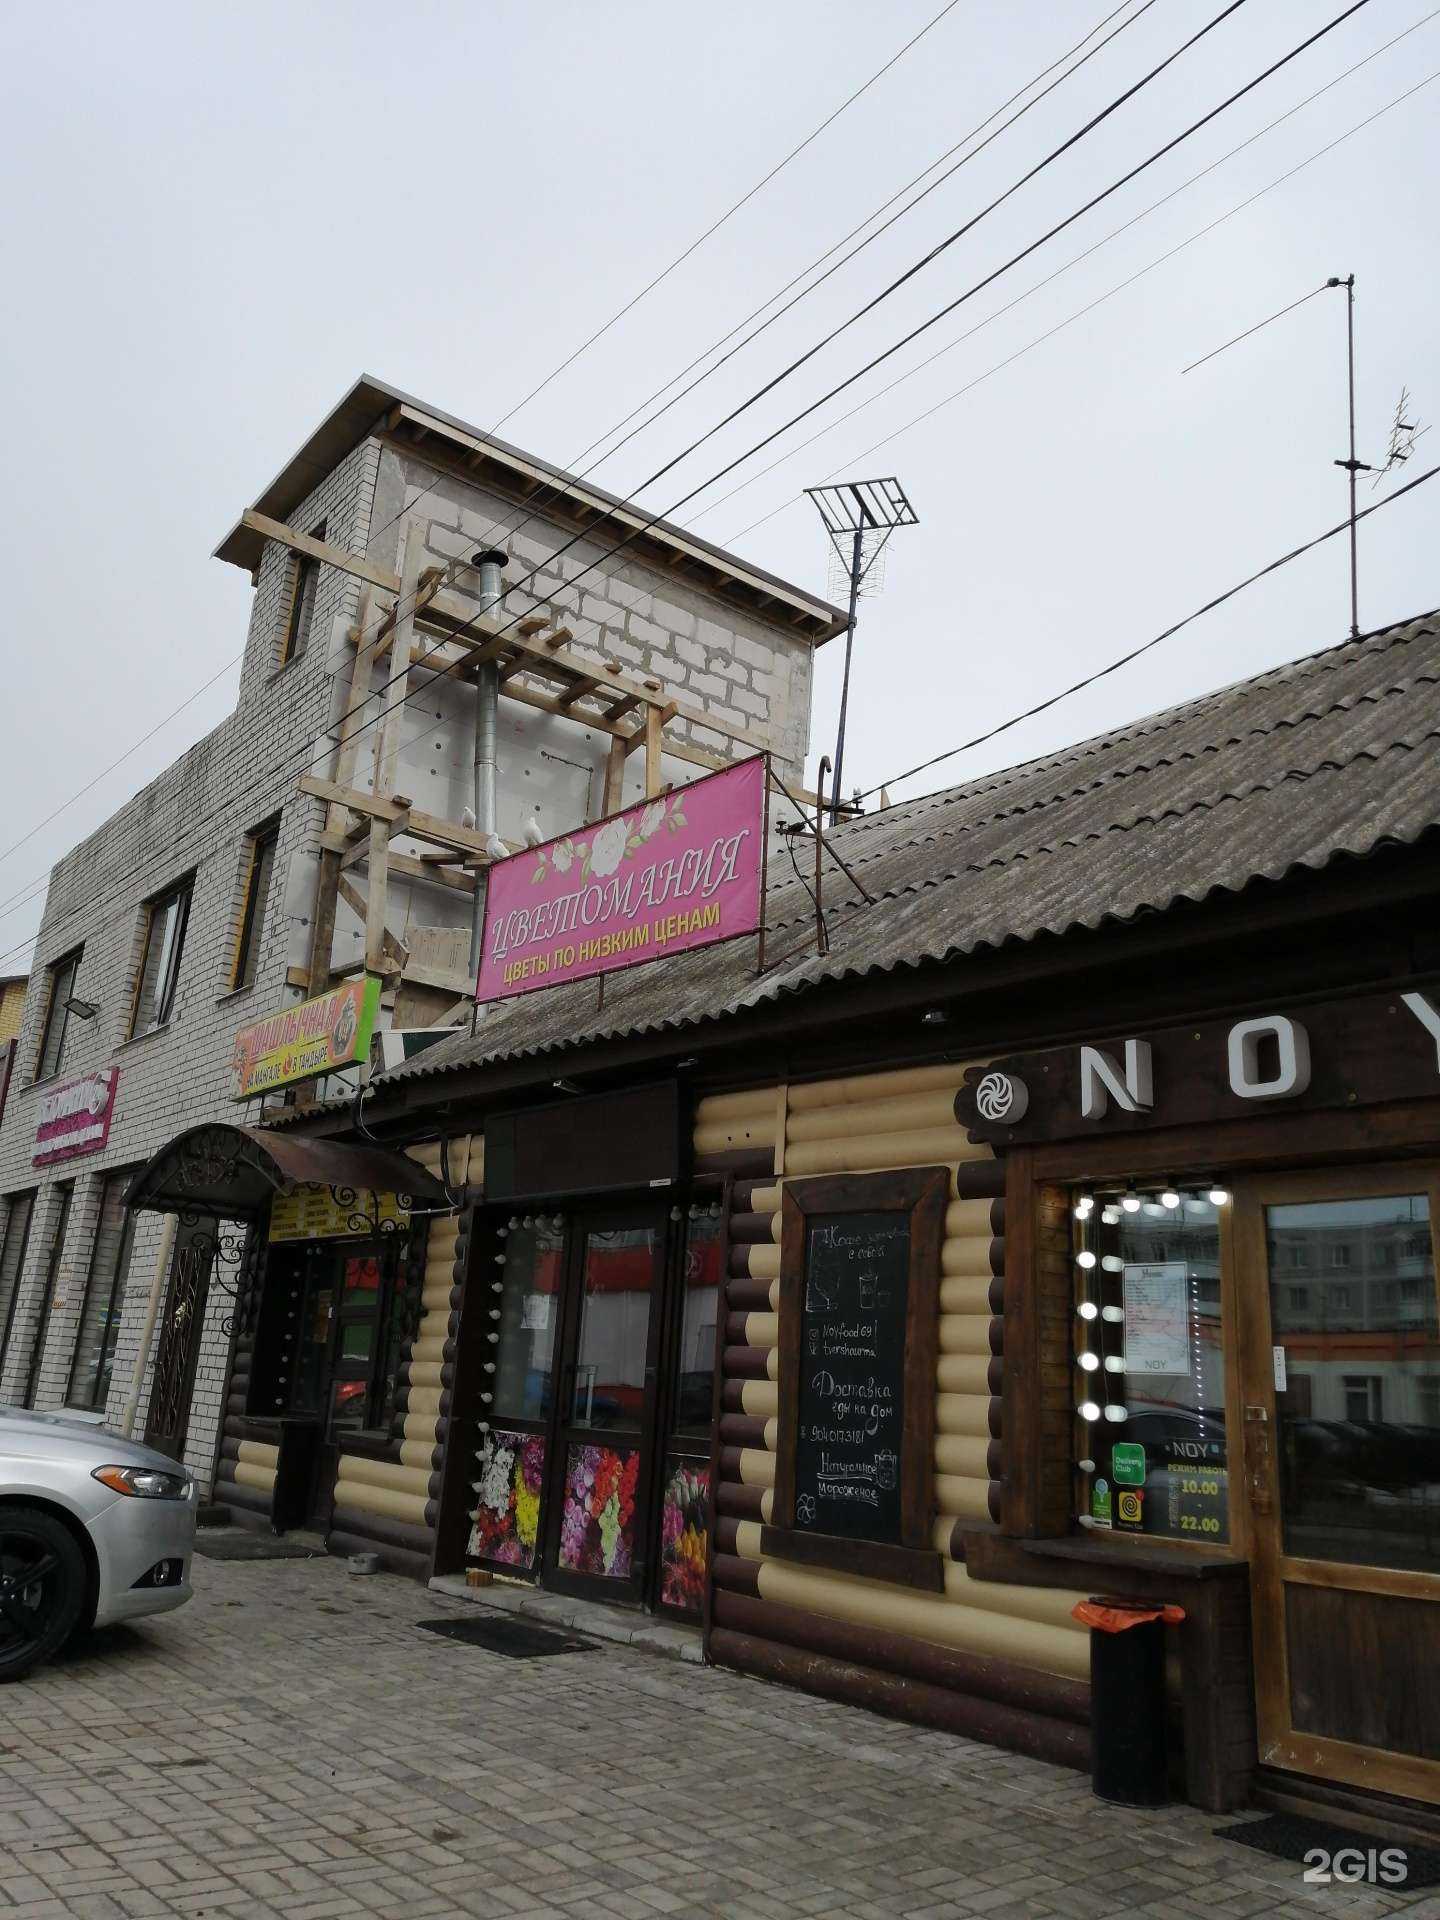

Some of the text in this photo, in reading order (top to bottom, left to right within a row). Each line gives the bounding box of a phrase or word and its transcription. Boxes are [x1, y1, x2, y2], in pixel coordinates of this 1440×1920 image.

[491, 830, 750, 965] ЦВЕТОМАНИЯ
[503, 902, 720, 986] ЦВЕТЫ ПО НИЗКИМ ЦЕНАМ
[251, 996, 338, 1057] ШАШЛЫЧНАЯ
[255, 1062, 282, 1085] МАНГАЛЕ
[291, 1056, 298, 1073] В
[299, 1045, 329, 1071] ТАНДЫРЕ
[1144, 1359, 1168, 1370] NOY
[811, 1370, 892, 1398] Доставка
[854, 1403, 867, 1415] на
[1172, 1441, 1208, 1458] NOY
[1115, 1456, 1142, 1467] Delivery
[1115, 1464, 1132, 1473] Club
[818, 1482, 880, 1500] Мороженое
[1181, 1479, 1219, 1496] 10.00
[1180, 1515, 1220, 1533] 22.00
